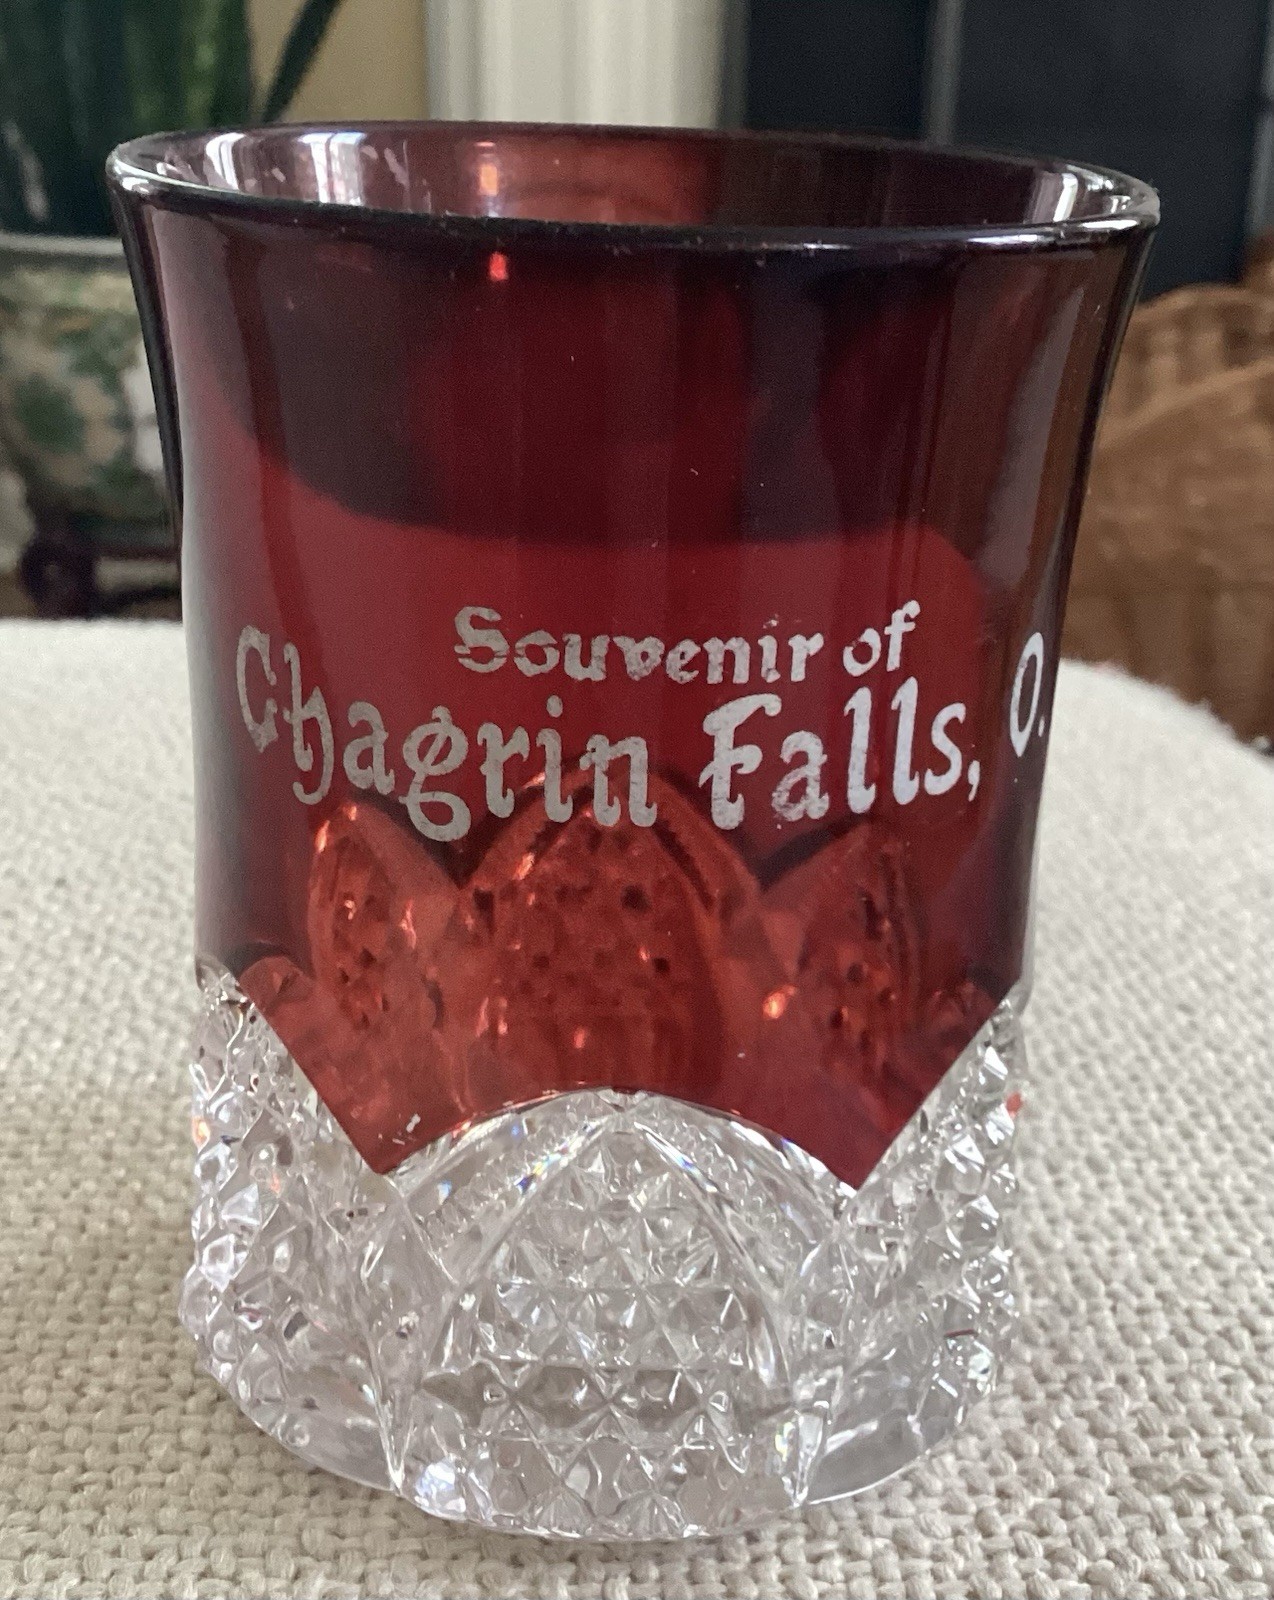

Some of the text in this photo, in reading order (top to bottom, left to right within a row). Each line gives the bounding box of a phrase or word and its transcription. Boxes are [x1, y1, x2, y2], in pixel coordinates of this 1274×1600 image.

[454, 600, 921, 684] Souvenir of
[236, 625, 1046, 842] Chagrin Falls, O.
